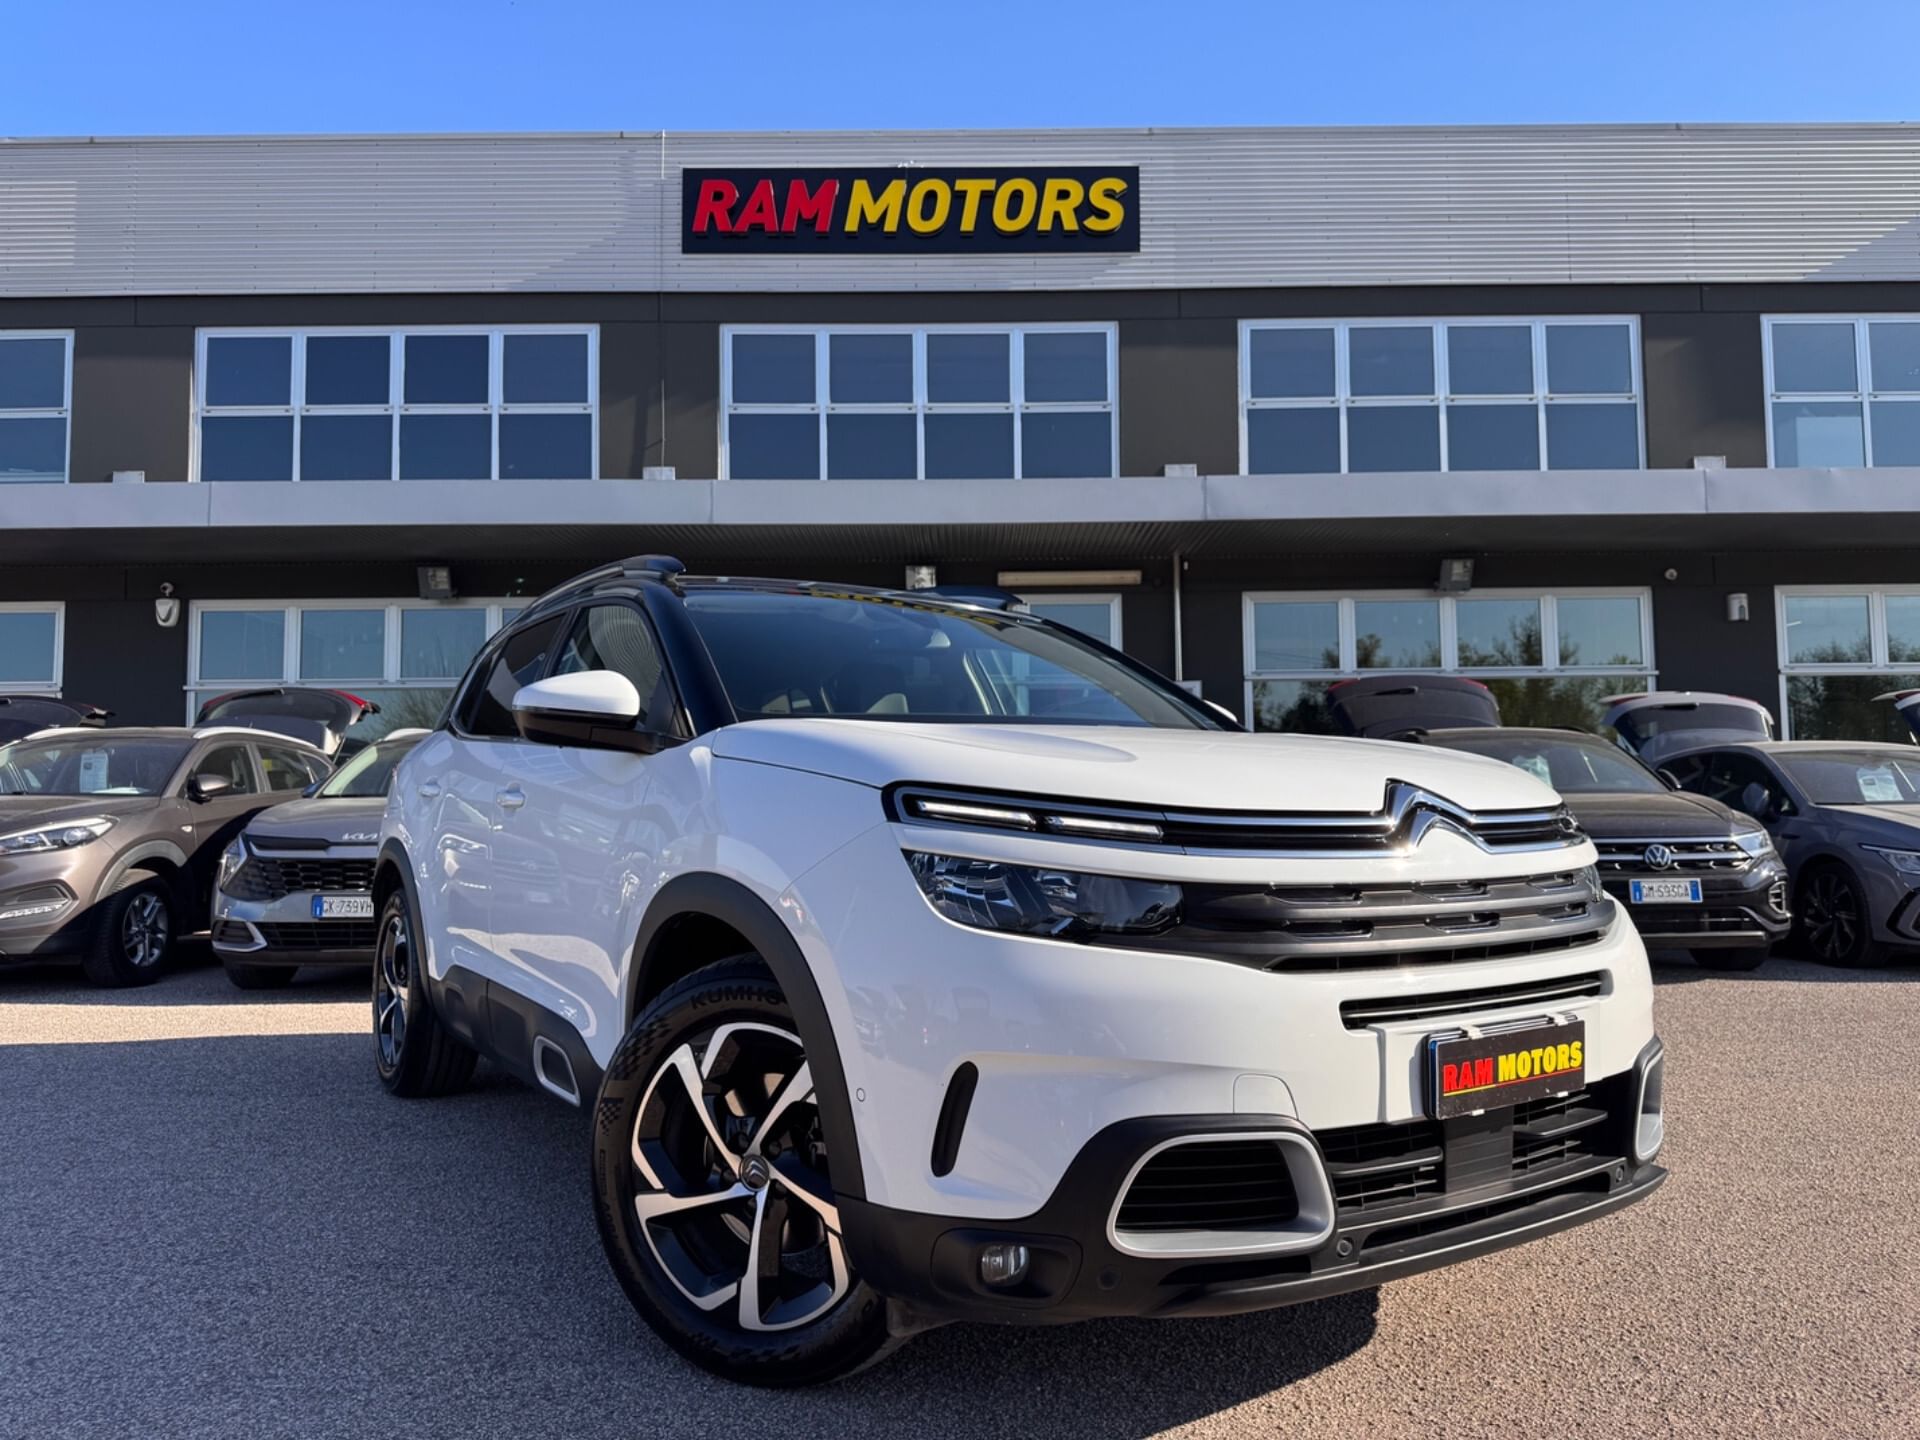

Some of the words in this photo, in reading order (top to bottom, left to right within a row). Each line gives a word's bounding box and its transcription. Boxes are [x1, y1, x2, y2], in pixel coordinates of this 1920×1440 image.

[691, 178, 839, 233] RAM
[844, 177, 1128, 233] MOTORS
[1443, 1057, 1494, 1093] RAM
[1498, 1040, 1583, 1083] MOTORS
